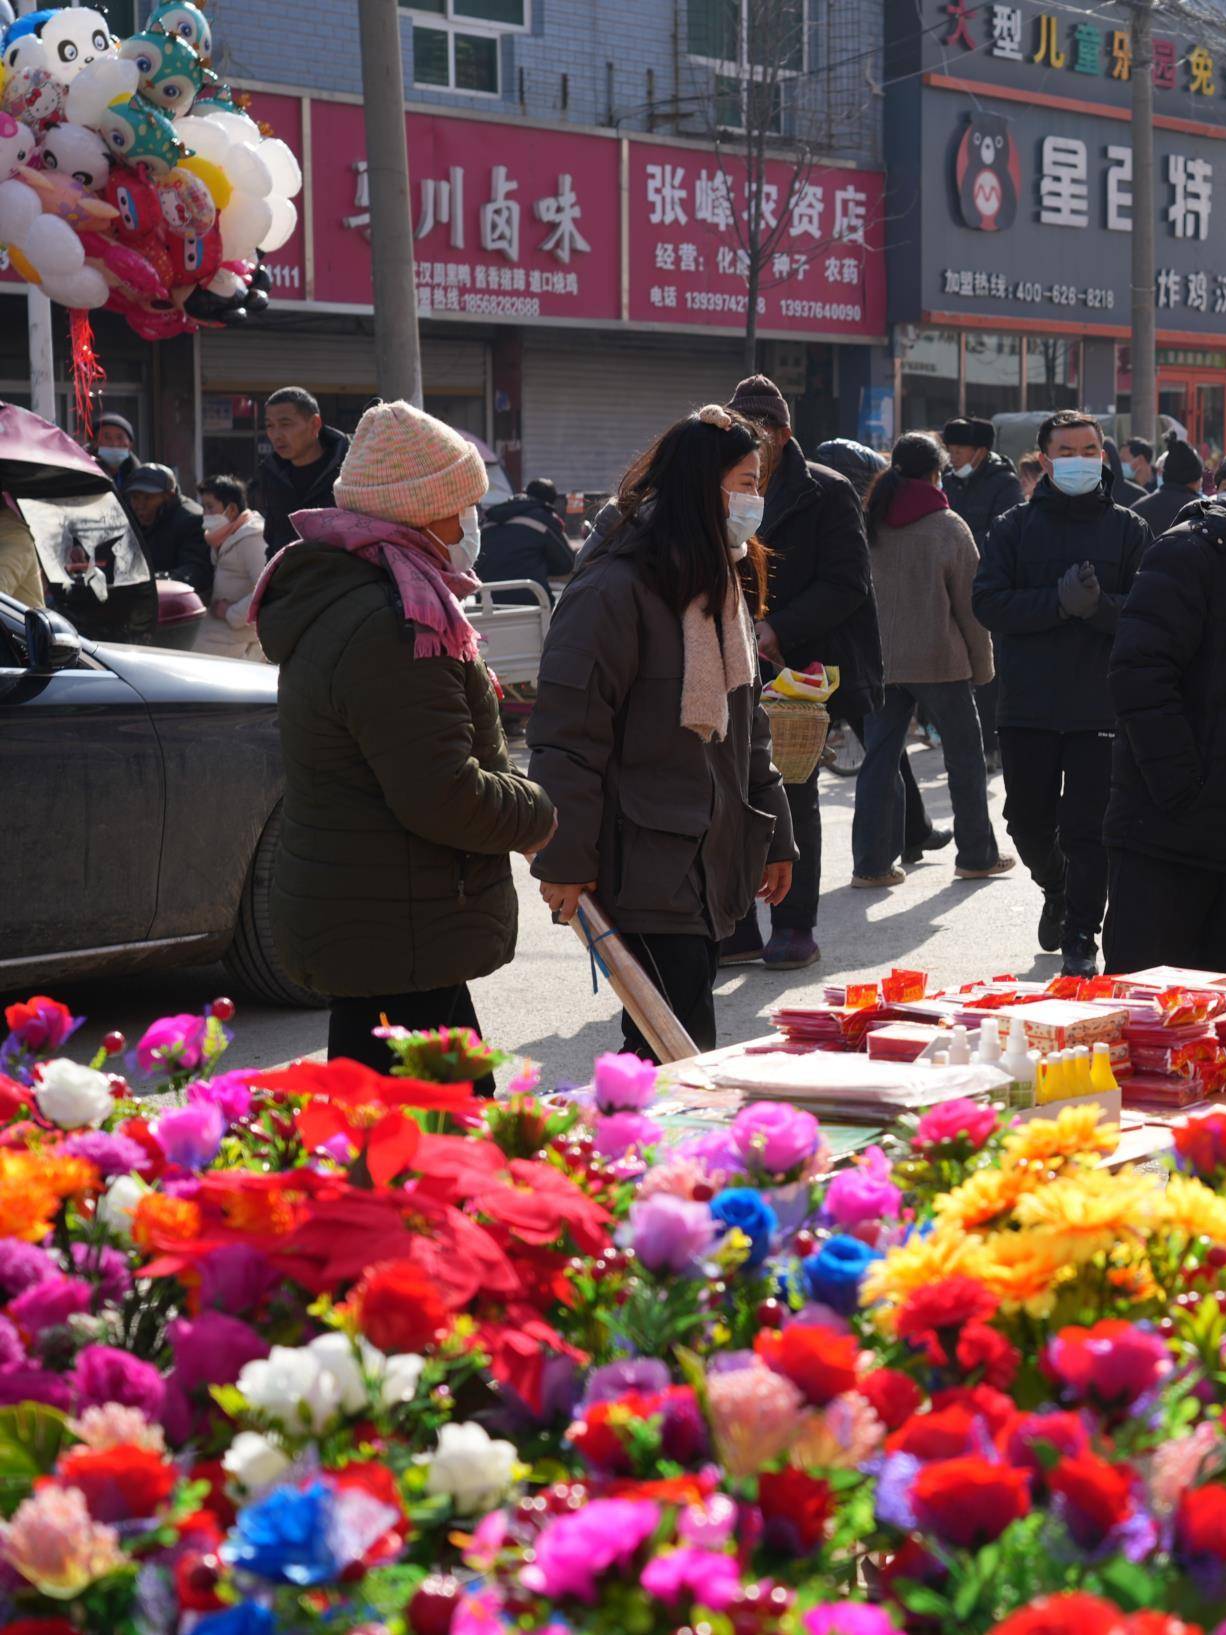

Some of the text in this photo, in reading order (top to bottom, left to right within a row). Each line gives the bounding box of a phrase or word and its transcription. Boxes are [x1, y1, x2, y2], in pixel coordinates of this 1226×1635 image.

[646, 164, 867, 245] 张峰农资店
[414, 261, 472, 288] 汉周黑鸭
[773, 253, 809, 281] 种子
[825, 256, 859, 285] 农药
[650, 285, 678, 308] 电话
[685, 292, 766, 315] 139397428
